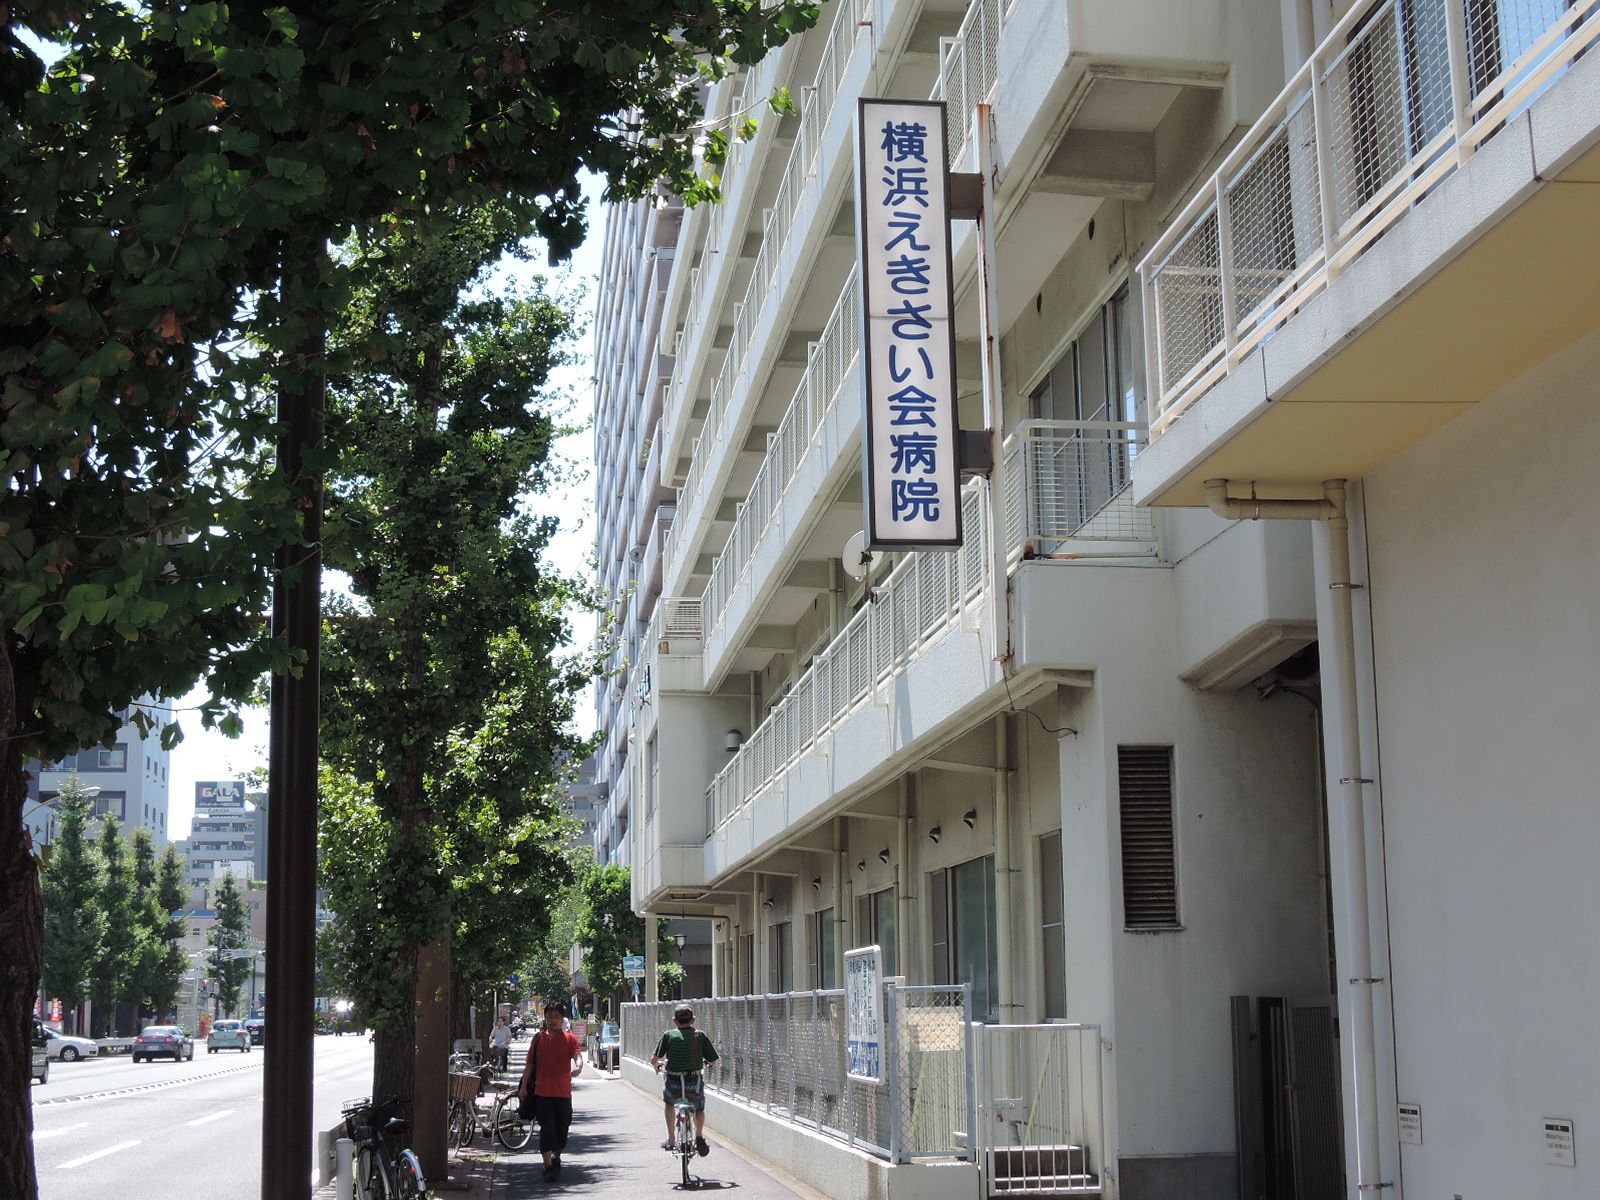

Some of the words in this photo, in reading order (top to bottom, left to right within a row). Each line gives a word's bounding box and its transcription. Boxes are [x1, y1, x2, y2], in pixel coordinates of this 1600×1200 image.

[881, 121, 939, 523] 横浜えきさい会病院
[202, 787, 240, 797] GALA
